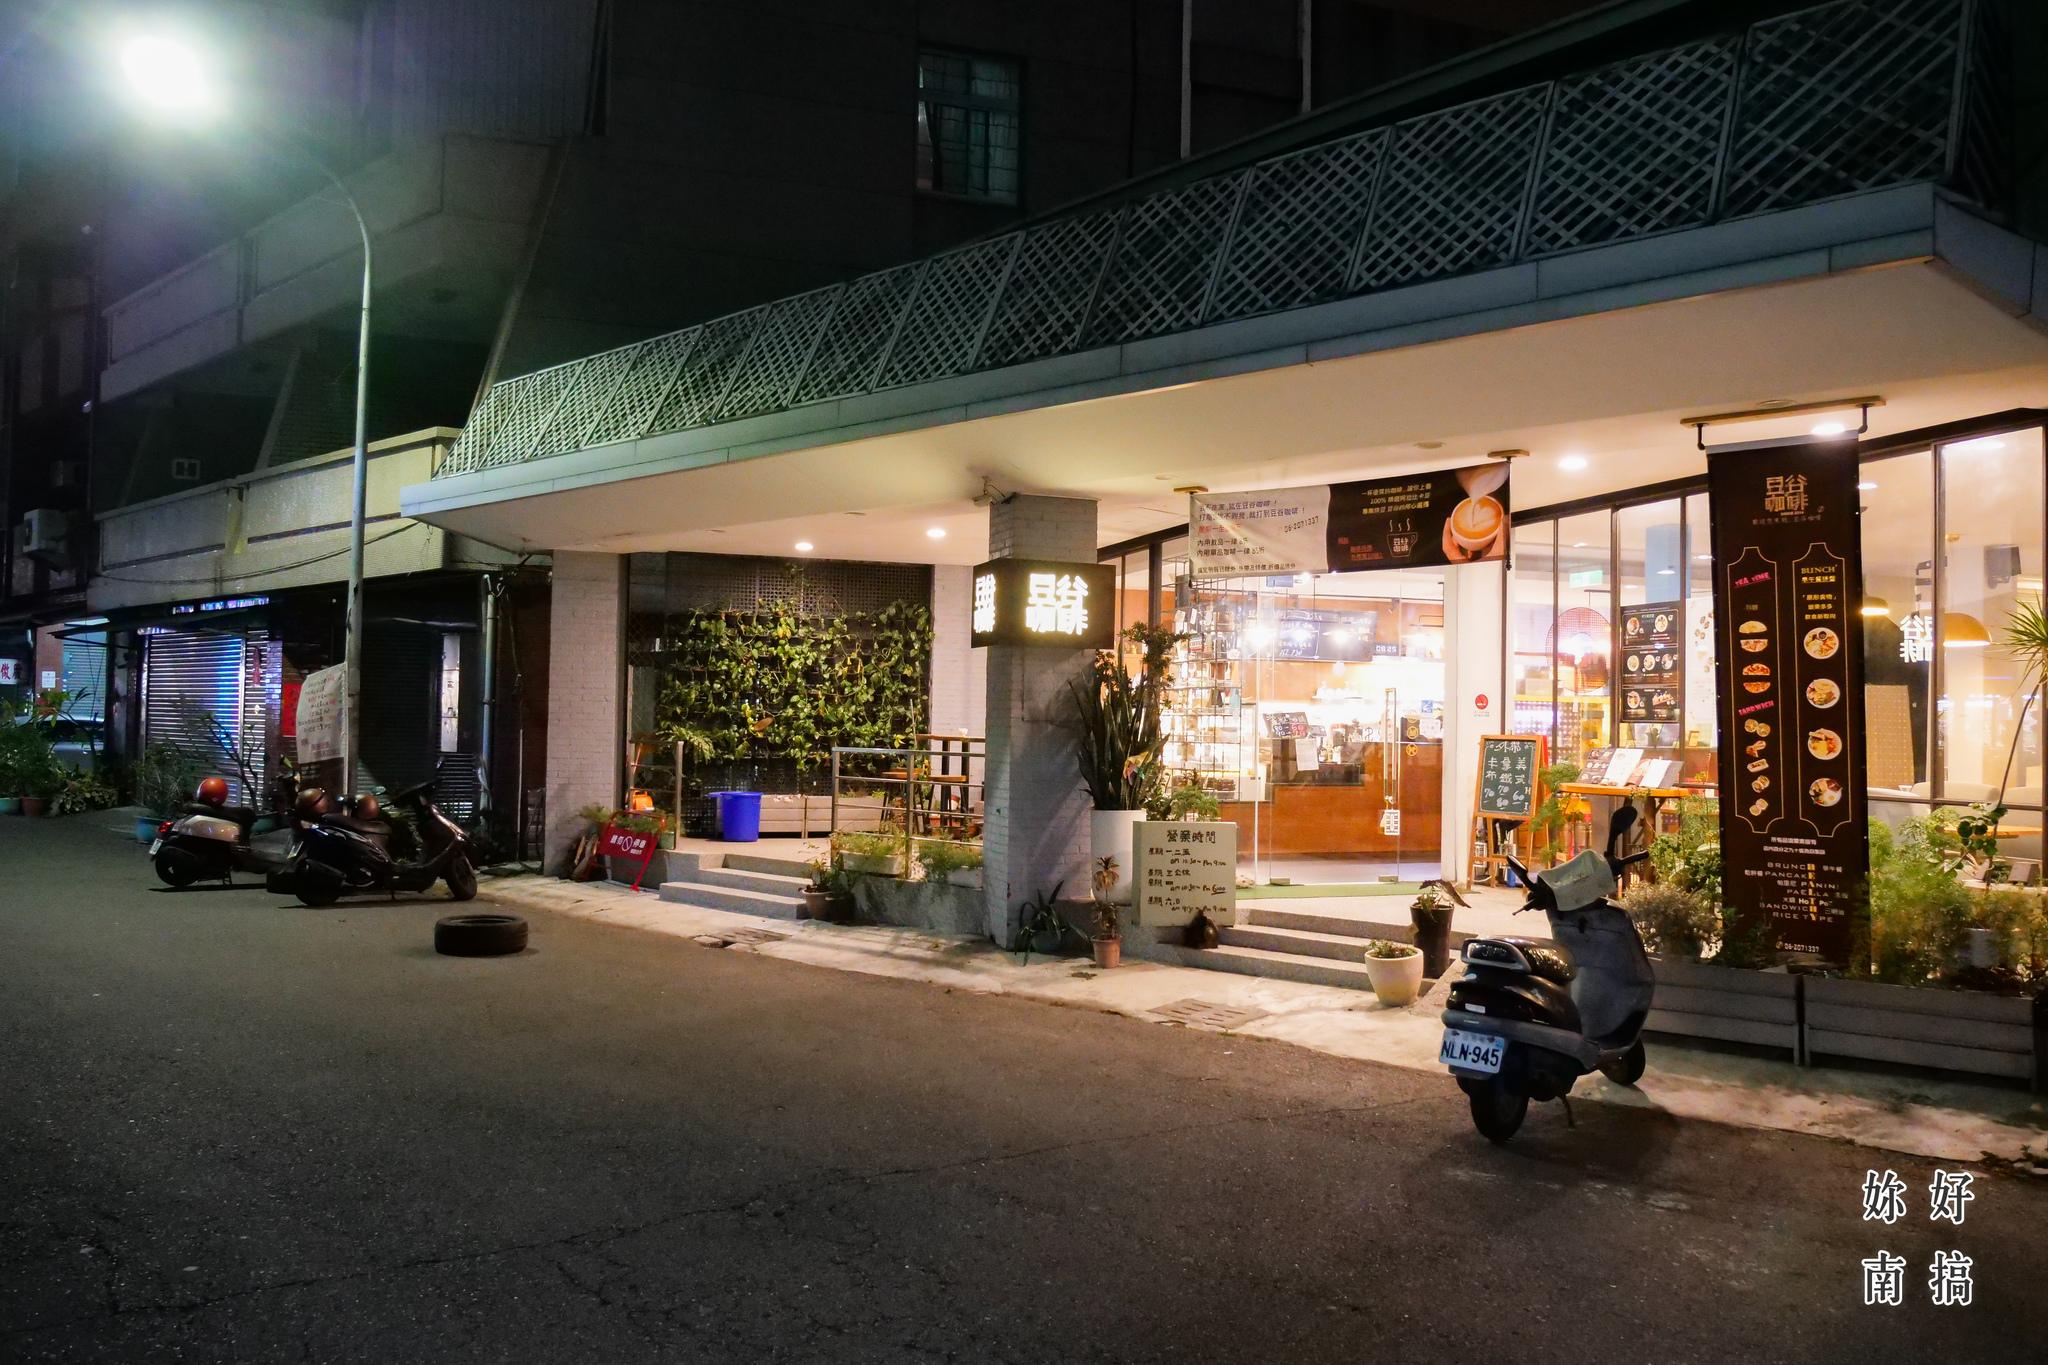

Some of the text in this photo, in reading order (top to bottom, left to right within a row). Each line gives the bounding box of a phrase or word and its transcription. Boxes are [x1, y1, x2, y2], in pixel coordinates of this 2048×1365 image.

[1766, 474, 1808, 495] 豆谷
[1765, 494, 1808, 512] 咖啡
[1734, 577, 1749, 587] TEA
[1028, 573, 1089, 604] 豆谷
[1738, 699, 1775, 716] SANDWICH
[1515, 756, 1527, 784] 美式
[1484, 788, 1495, 798] 70
[1498, 785, 1509, 794] 70
[1512, 790, 1524, 801] 60
[1166, 829, 1216, 844] 營業時間
[1767, 861, 1815, 871] BRUNCH
[1765, 871, 1816, 880] PANCAKE
[1787, 889, 1830, 897] PAELLA
[1760, 902, 1818, 913] SANDWICH
[1772, 911, 1798, 920] RICE
[1784, 943, 1820, 953] 06-2071337
[1441, 1040, 1500, 1067] NLN-945
